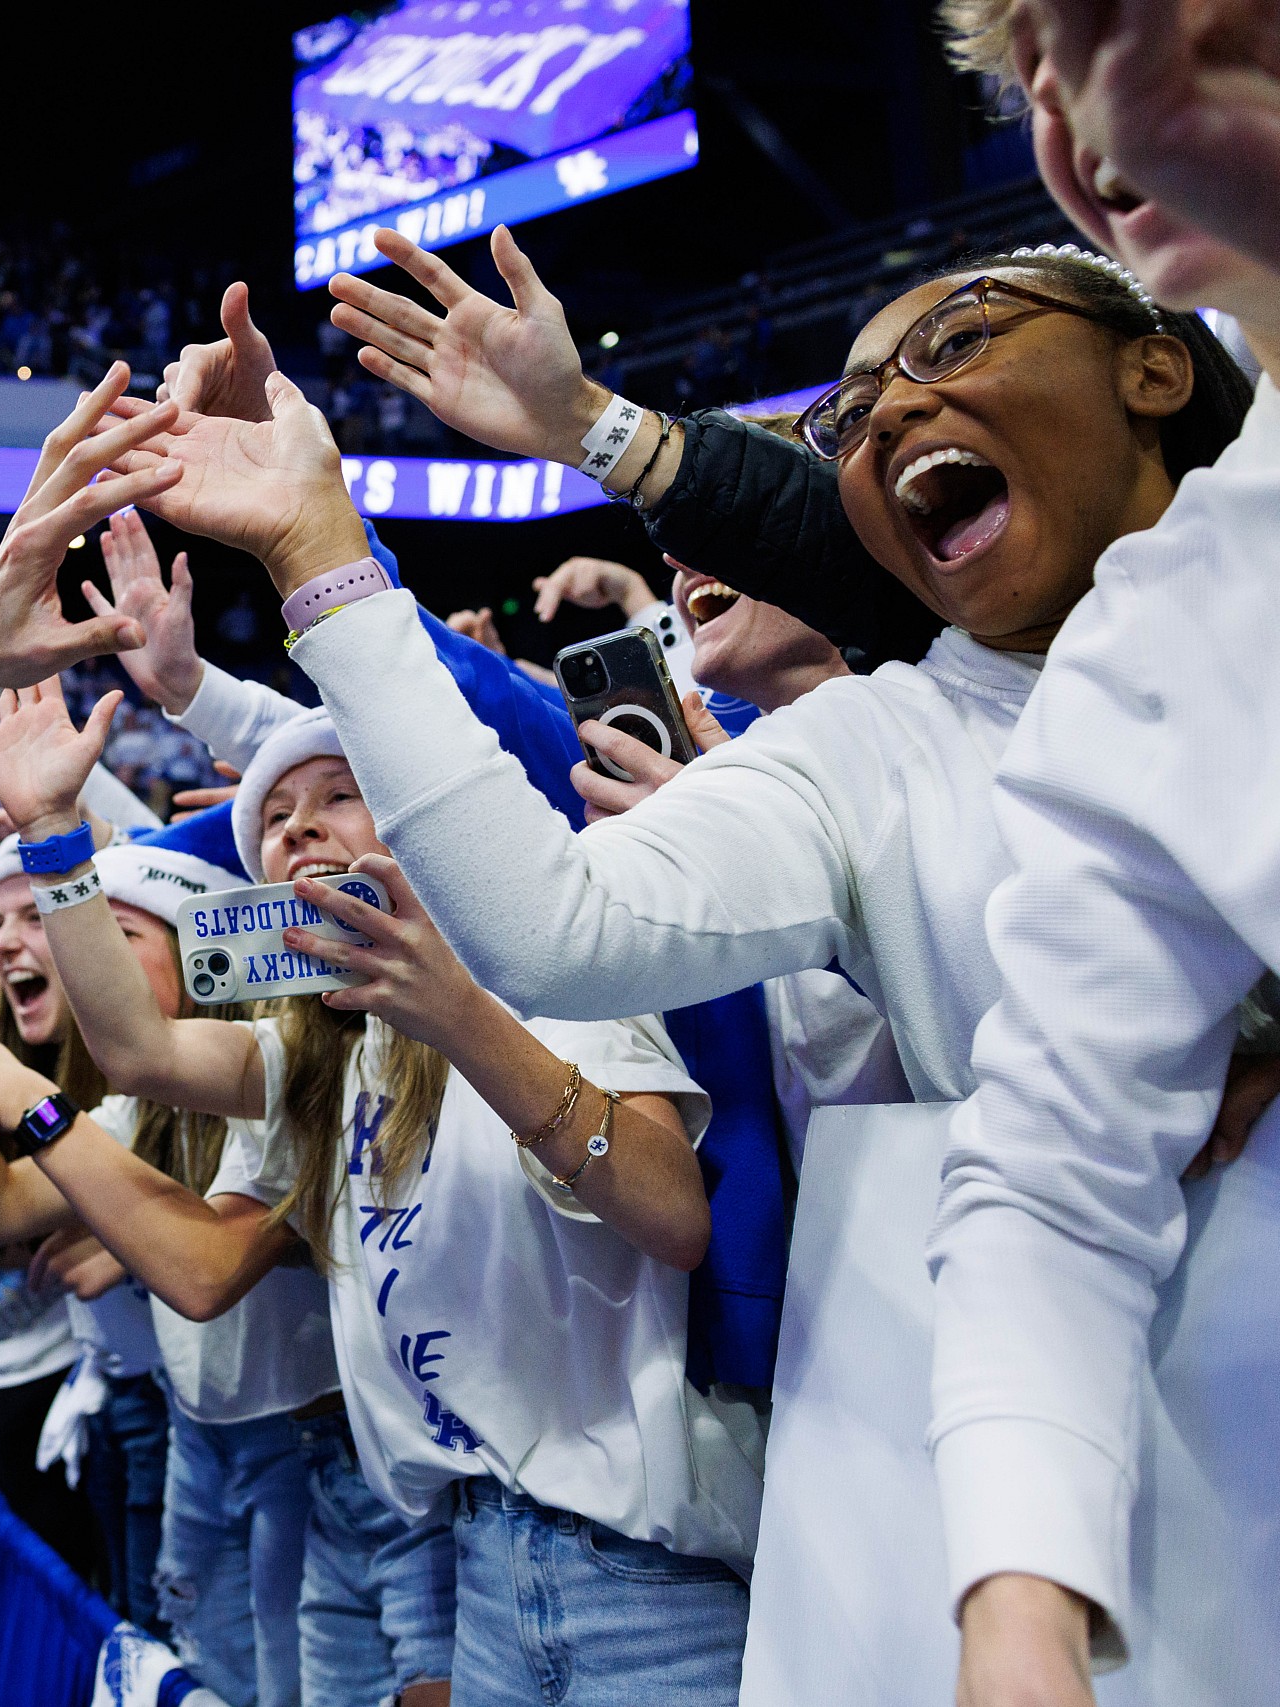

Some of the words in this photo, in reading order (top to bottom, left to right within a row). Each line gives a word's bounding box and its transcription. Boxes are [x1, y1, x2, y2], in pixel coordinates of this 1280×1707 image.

[426, 461, 565, 518] WIN!
[194, 898, 324, 939] WILDCATS
[246, 947, 362, 984] TUCKY
